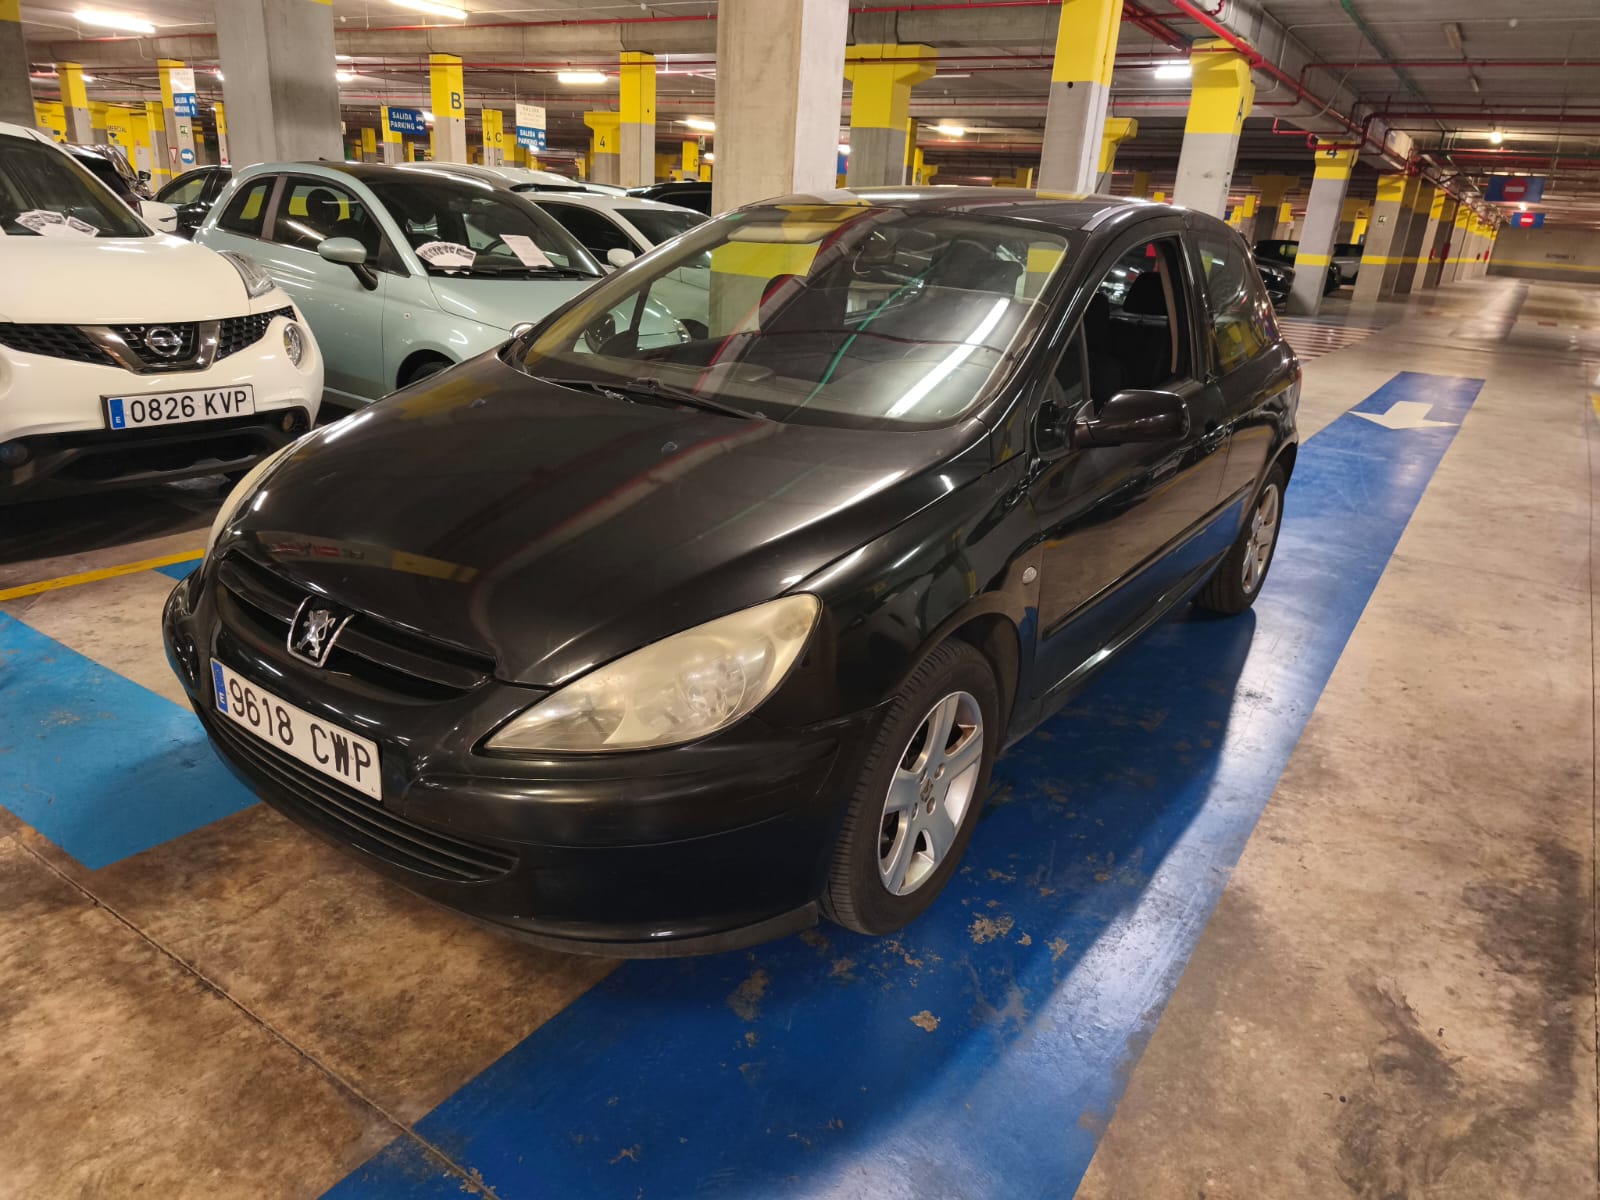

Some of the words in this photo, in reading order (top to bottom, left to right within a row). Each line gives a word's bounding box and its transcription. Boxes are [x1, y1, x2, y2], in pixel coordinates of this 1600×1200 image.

[451, 91, 462, 109] B
[392, 111, 413, 121] SALIDA
[390, 120, 415, 130] PARKING
[495, 131, 502, 143] C
[519, 129, 536, 138] SALIDA
[599, 135, 606, 148] 4
[130, 395, 195, 423] 0826
[204, 390, 247, 416] KVP
[229, 678, 294, 746] 9618
[310, 723, 371, 783] CWP
